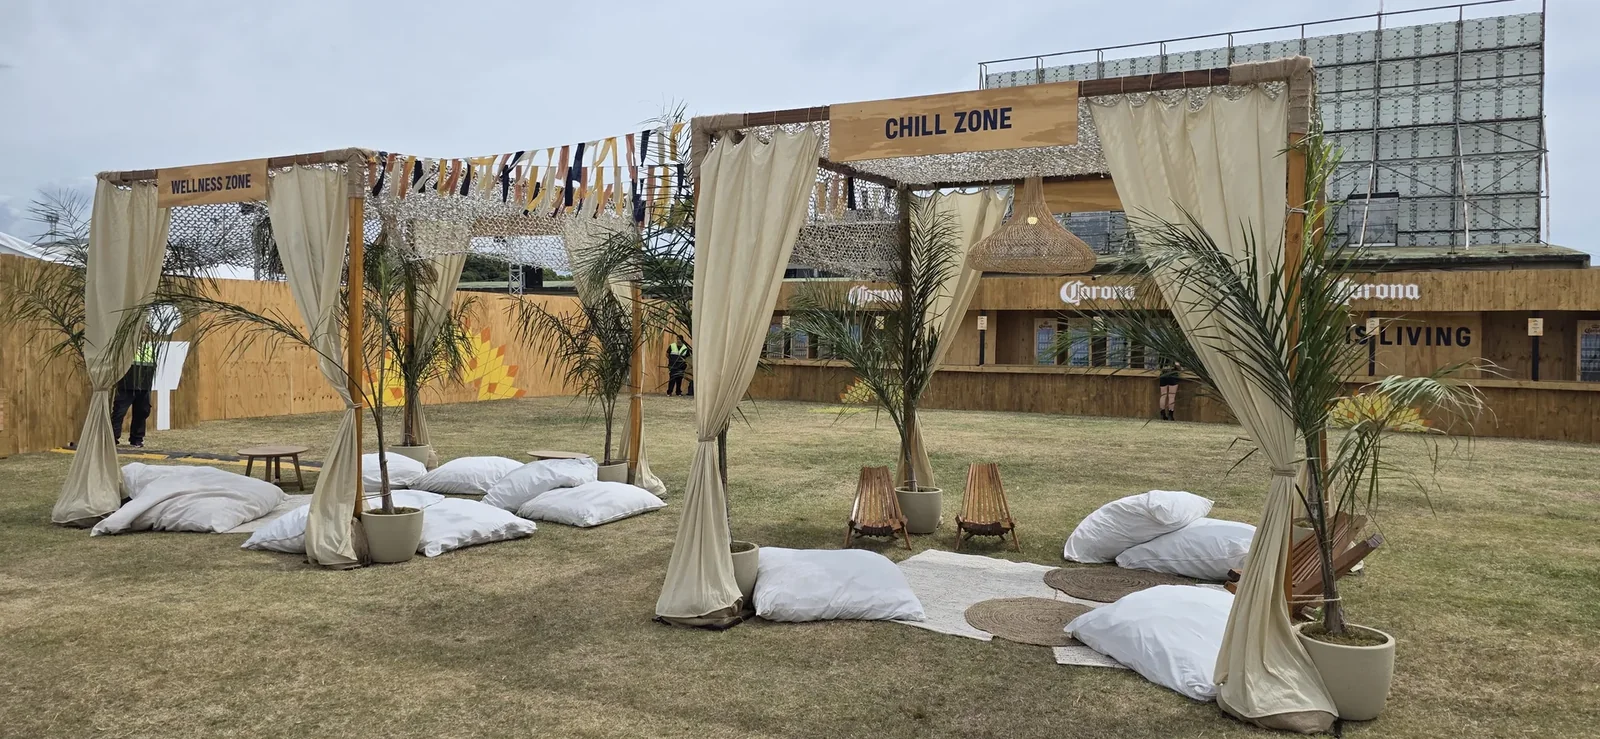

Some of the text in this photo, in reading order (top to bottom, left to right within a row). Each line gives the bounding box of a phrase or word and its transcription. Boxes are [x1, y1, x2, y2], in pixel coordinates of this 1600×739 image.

[885, 107, 1012, 140] CHILL ZONE
[171, 174, 251, 195] WELLNESS ZONE
[848, 285, 903, 308] Coron
[1060, 280, 1136, 307] Corona
[1380, 326, 1471, 347] LIVING
